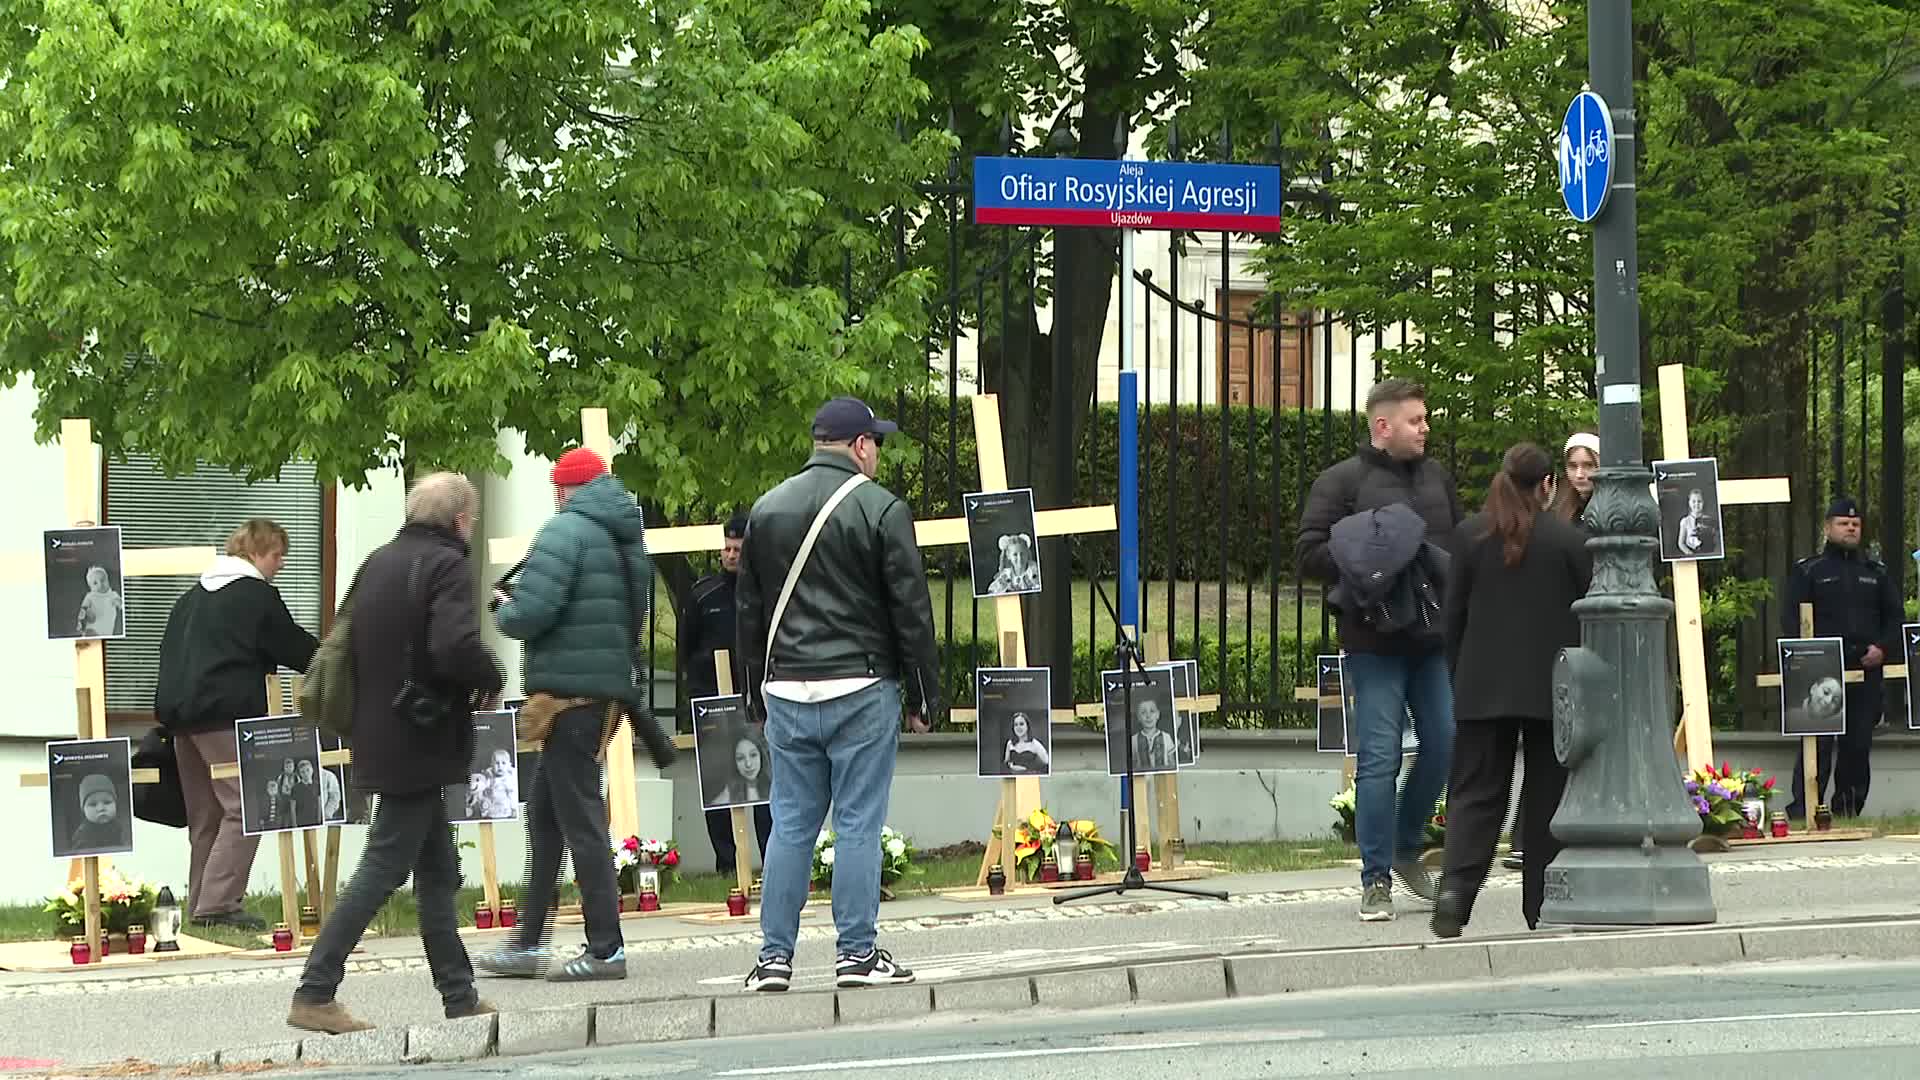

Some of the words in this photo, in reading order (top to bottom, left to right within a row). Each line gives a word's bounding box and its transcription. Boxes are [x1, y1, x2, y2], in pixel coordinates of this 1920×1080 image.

[1119, 164, 1144, 178] Aleja
[1001, 174, 1057, 201] Ofiar
[1065, 176, 1174, 211] Rosyjskiej
[1182, 180, 1257, 214] Agresji
[1110, 212, 1153, 227] Ujazdów
